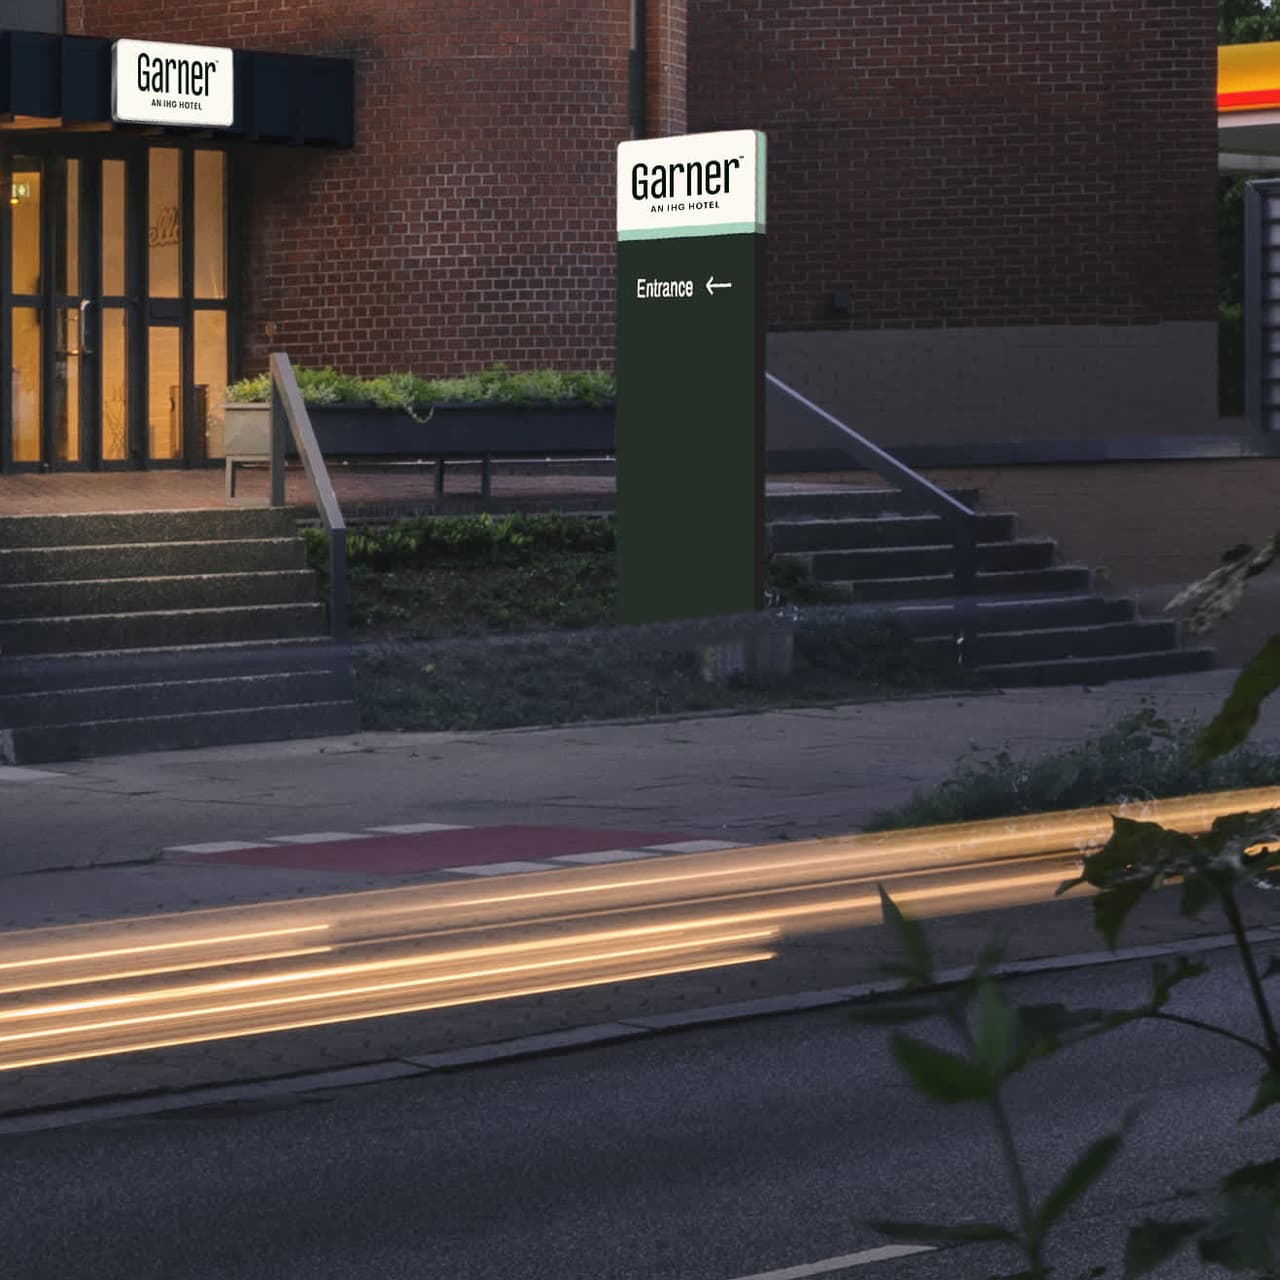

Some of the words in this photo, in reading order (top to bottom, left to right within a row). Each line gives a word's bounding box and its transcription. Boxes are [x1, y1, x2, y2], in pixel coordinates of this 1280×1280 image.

[137, 52, 217, 97] Garner
[151, 99, 162, 107] AN
[163, 100, 177, 109] IHG
[179, 101, 203, 111] HOTEL
[632, 158, 740, 200] Garner
[650, 205, 664, 213] AN
[667, 204, 685, 212] IHG
[688, 201, 720, 210] HOTEL
[637, 278, 694, 298] Entrance
